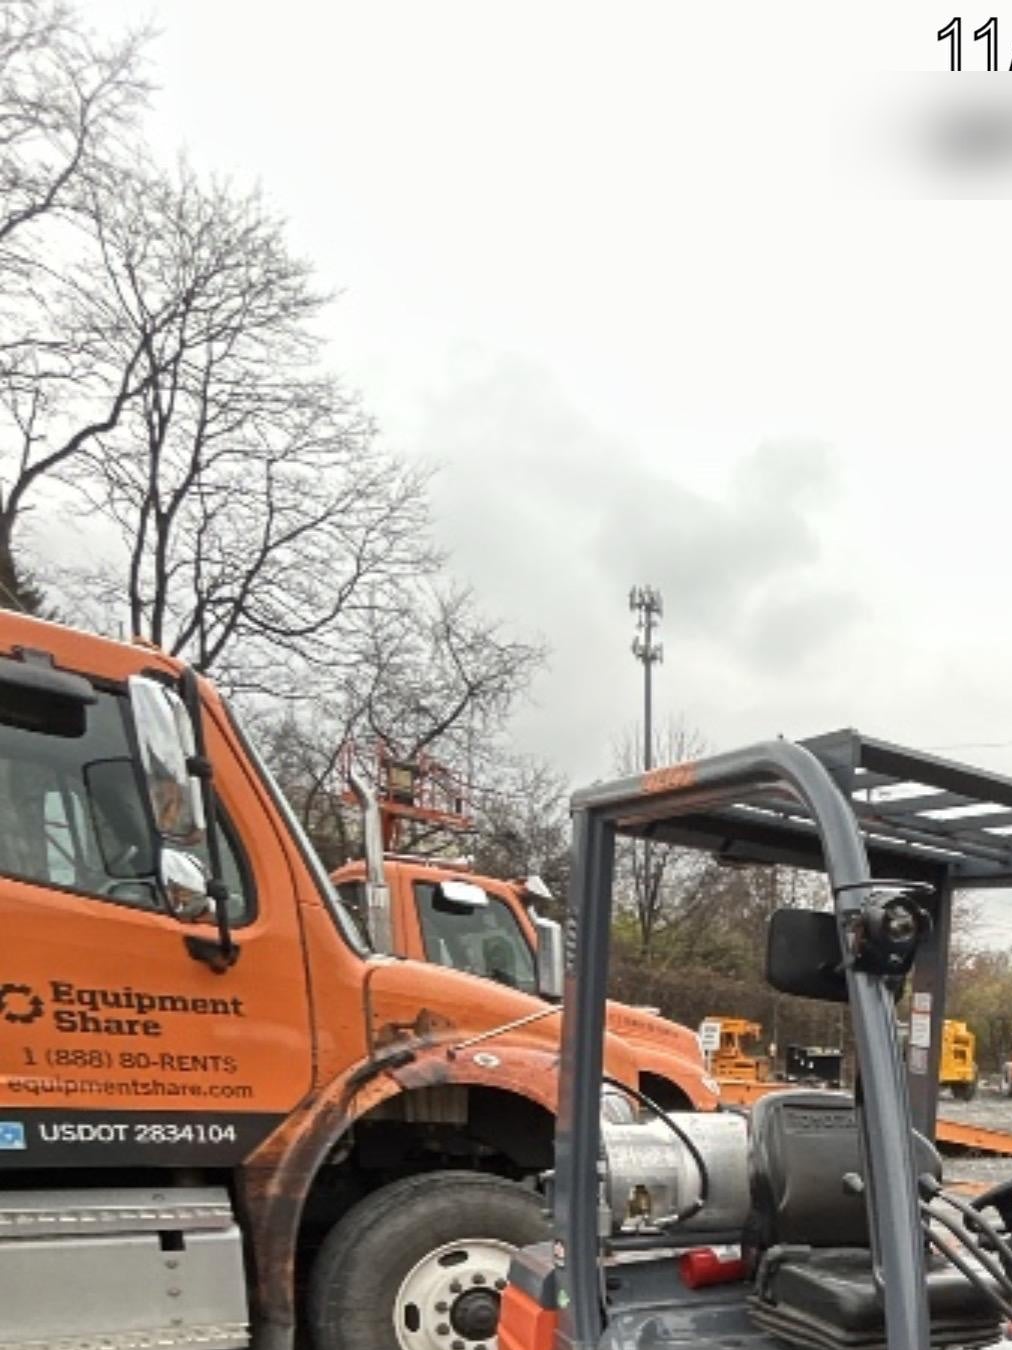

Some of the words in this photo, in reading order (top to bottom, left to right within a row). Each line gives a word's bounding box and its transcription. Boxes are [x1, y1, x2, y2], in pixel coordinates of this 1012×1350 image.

[50, 981, 245, 1017] Equipment
[55, 1010, 162, 1037] Share
[23, 1047, 37, 1066] 1
[46, 1049, 112, 1069] (888)
[119, 1053, 238, 1074] 80-RENTS
[8, 1077, 254, 1099] equipmentshare.com
[39, 1124, 129, 1142] USDOT
[133, 1124, 237, 1144] 2834104
